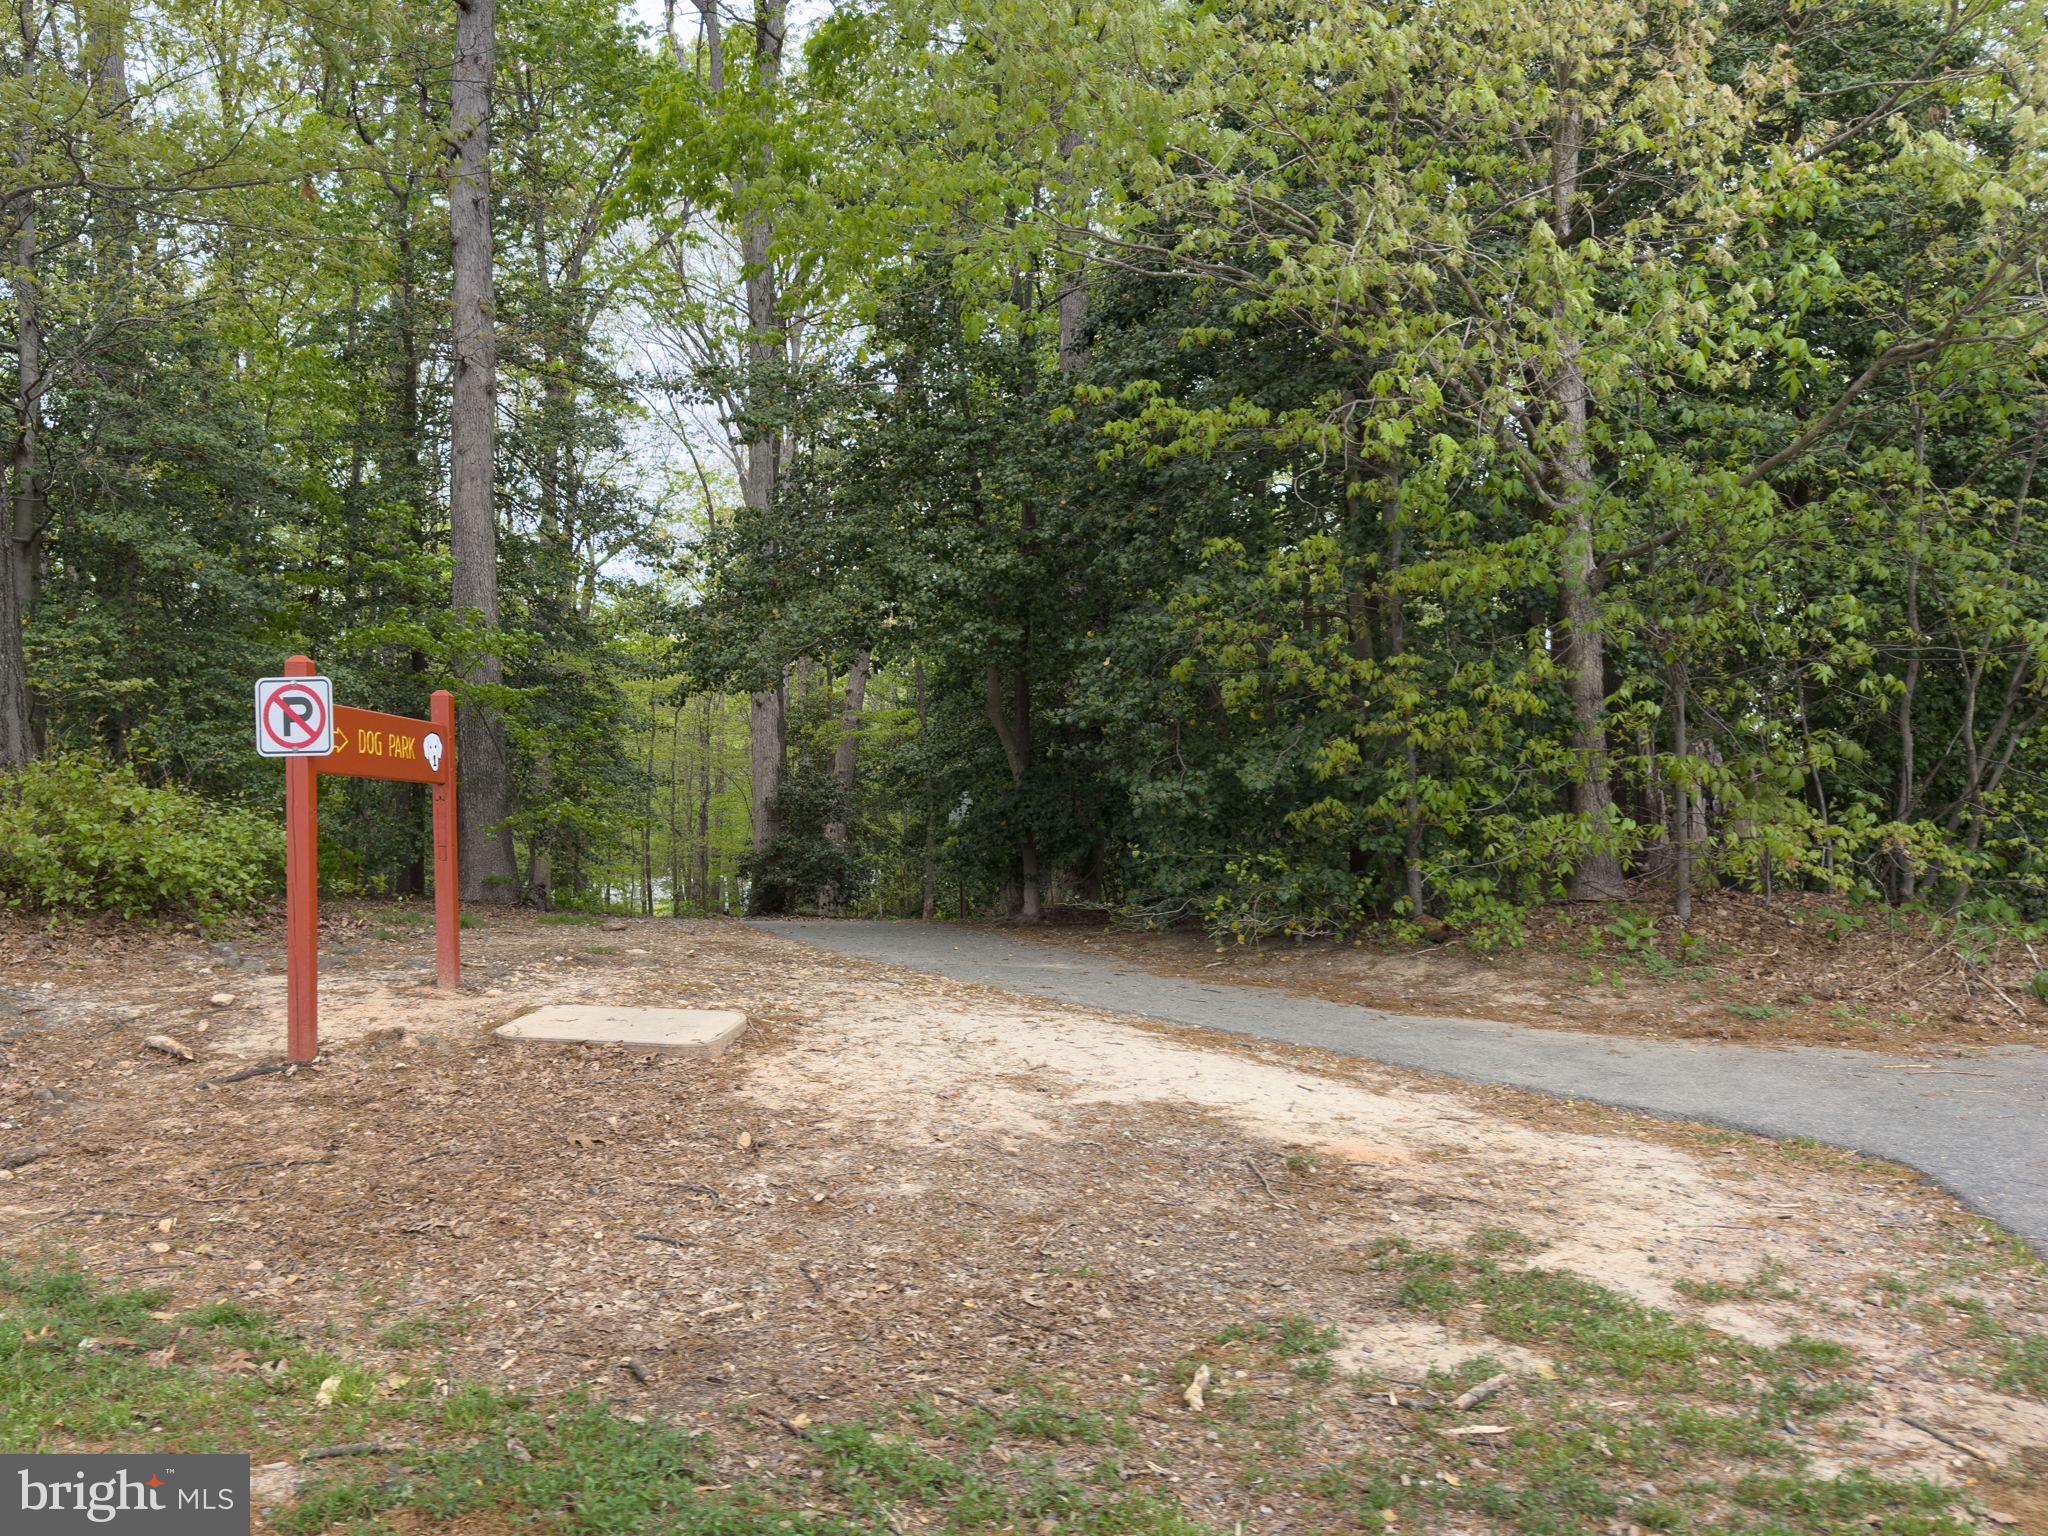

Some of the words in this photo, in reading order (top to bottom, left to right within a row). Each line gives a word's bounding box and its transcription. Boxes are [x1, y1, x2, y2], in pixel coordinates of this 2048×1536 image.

[283, 696, 313, 737] P
[358, 728, 382, 756] DOG
[388, 733, 416, 760] PARK
